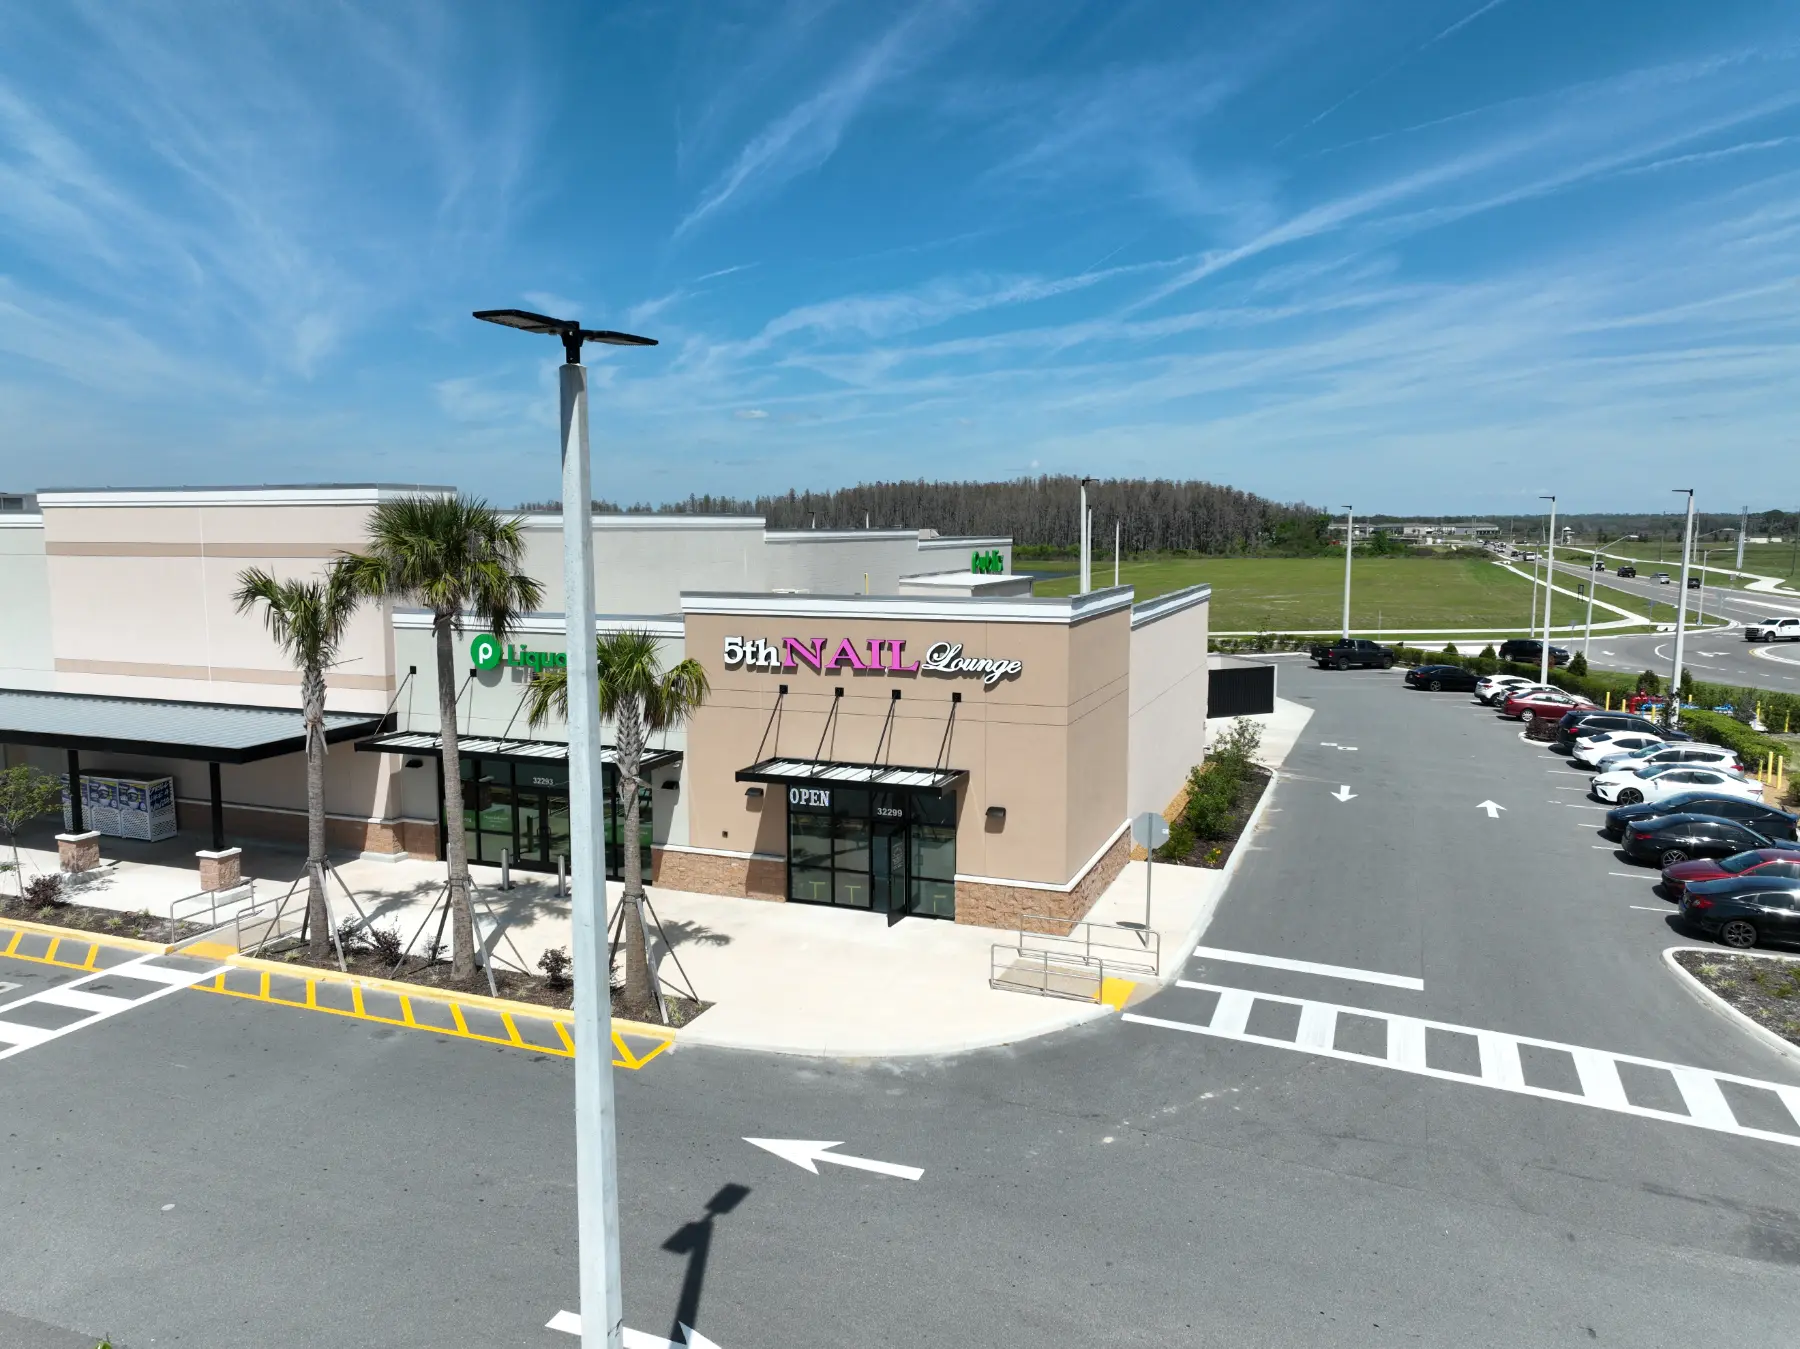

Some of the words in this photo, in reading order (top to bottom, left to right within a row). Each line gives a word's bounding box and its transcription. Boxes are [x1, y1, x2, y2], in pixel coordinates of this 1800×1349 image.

[507, 644, 568, 673] Liquo
[724, 636, 780, 667] 5th
[781, 637, 920, 672] NAIL
[921, 642, 1022, 684] Lounge
[532, 776, 554, 786] 32293
[789, 788, 831, 807] OPEN
[877, 807, 903, 818] 32299
